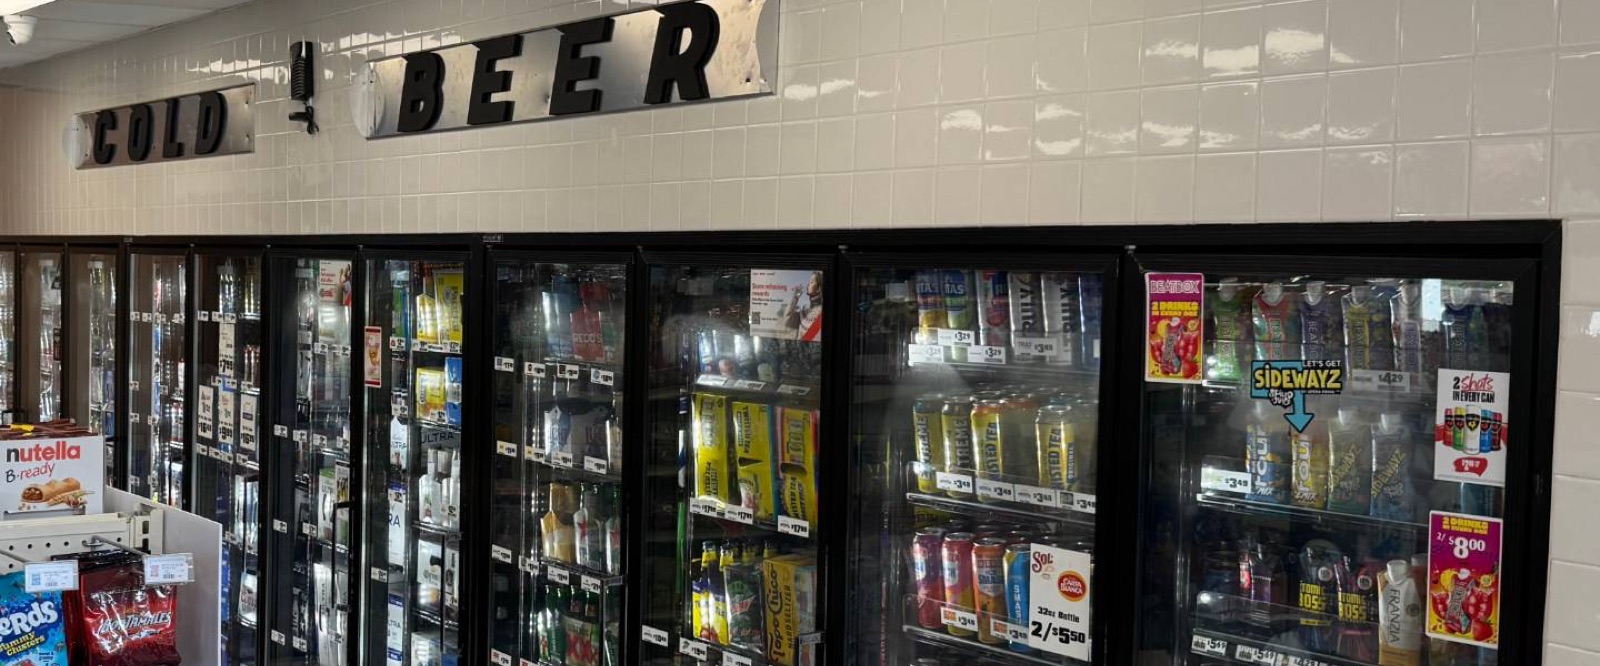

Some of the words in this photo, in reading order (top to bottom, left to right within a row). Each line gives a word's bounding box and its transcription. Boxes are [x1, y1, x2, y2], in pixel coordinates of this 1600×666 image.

[92, 91, 228, 165] COLD
[397, 0, 720, 133] BEER
[1150, 280, 1200, 294] BEATBOX
[1020, 287, 1034, 333] RULY
[1151, 301, 1158, 310] 2
[1159, 301, 1198, 310] DRINKS
[1453, 376, 1460, 390] 2
[6, 441, 81, 463] nutella
[5, 462, 56, 484] B-ready
[1388, 589, 1401, 643] FRANZIA
